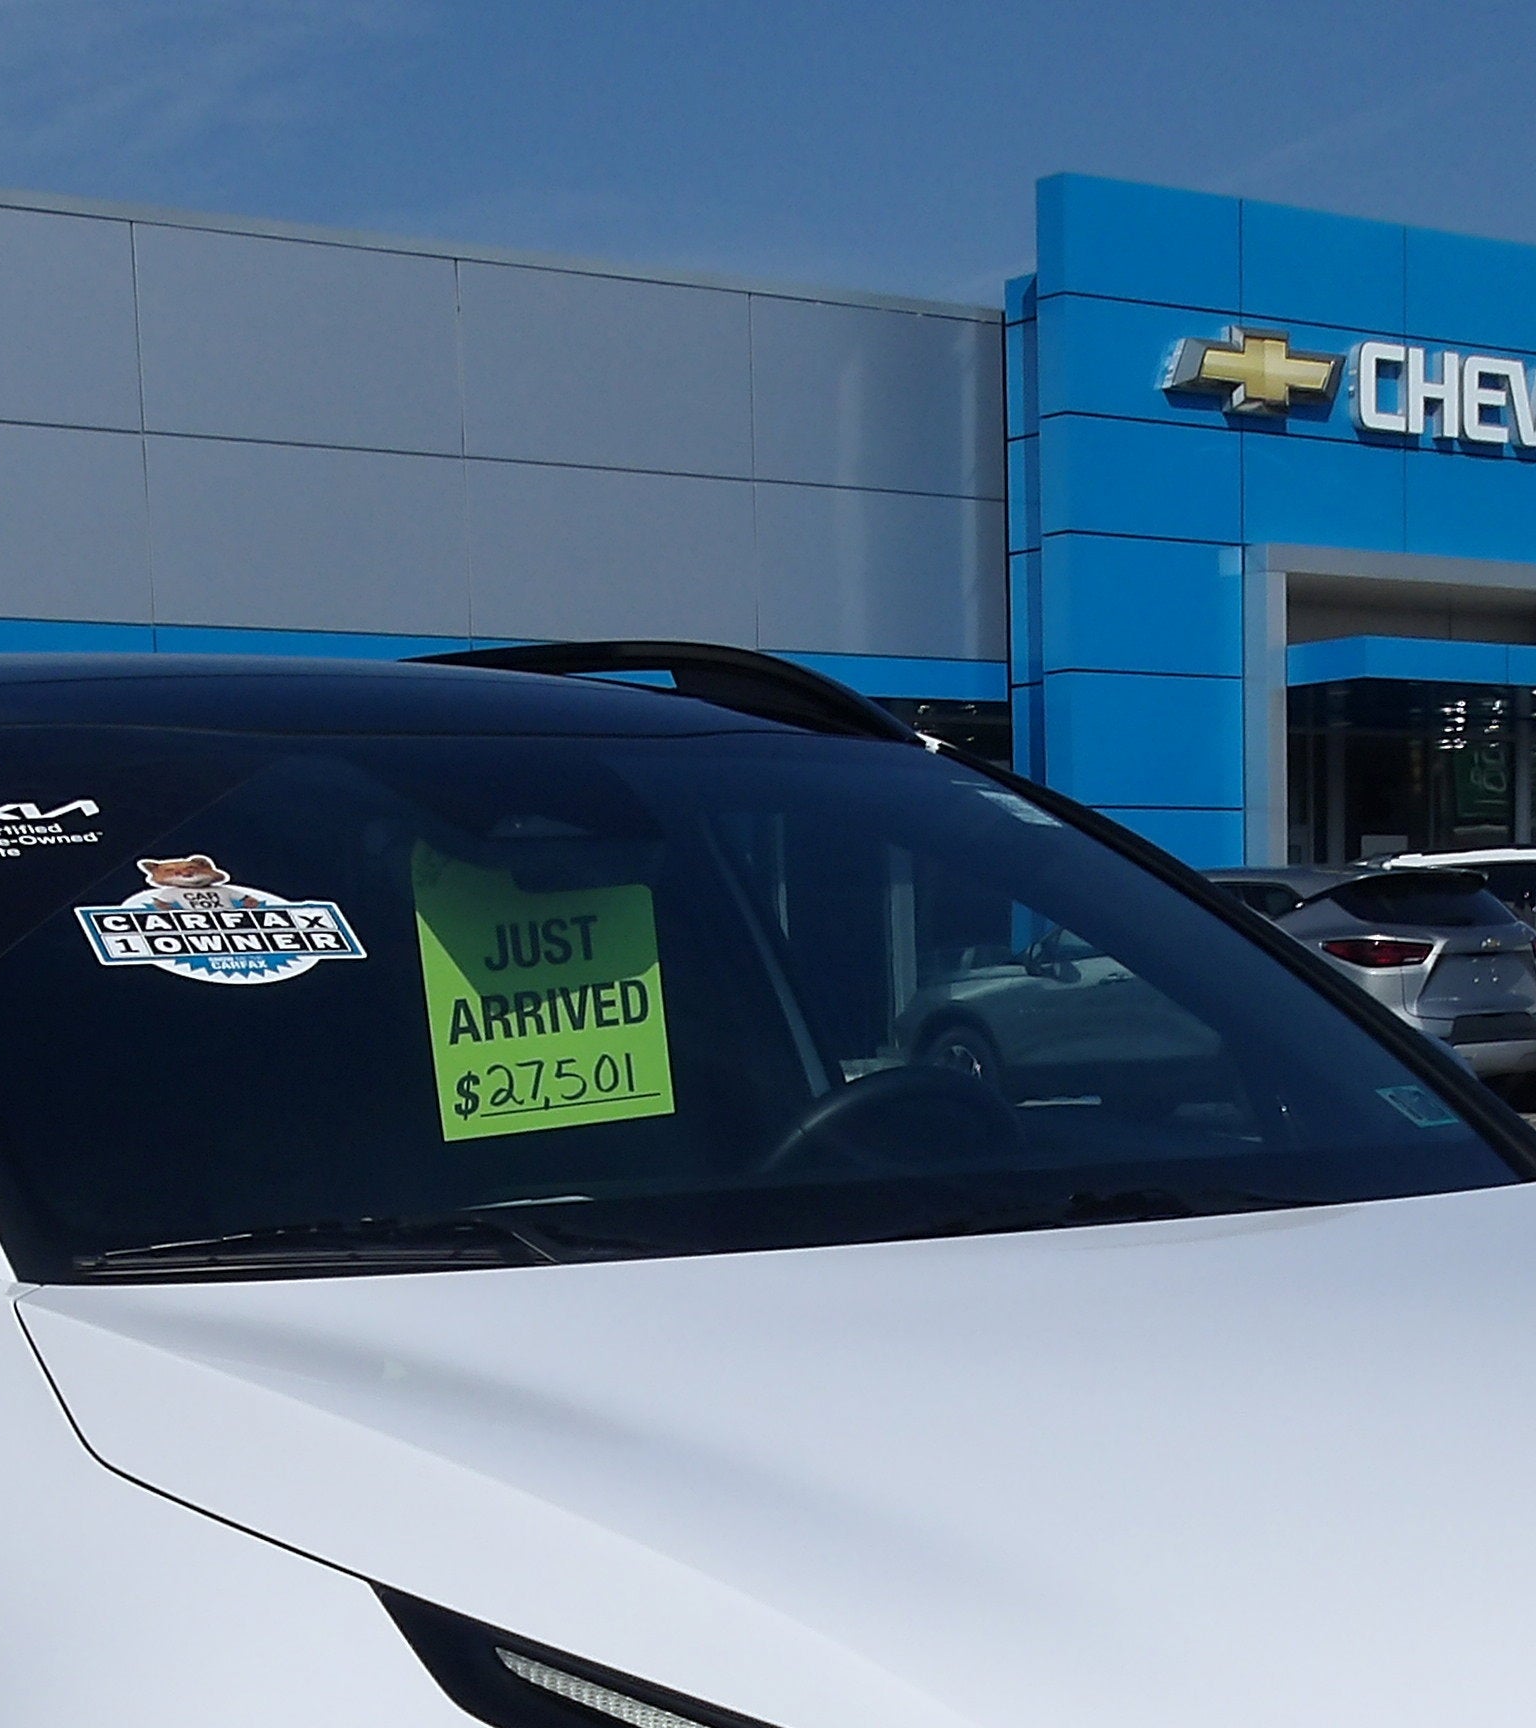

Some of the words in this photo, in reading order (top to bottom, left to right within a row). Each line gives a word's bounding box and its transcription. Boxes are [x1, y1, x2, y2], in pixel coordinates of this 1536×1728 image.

[102, 911, 330, 933] CARFAX
[153, 932, 341, 954] OWNER
[484, 915, 599, 971] JUST
[449, 979, 649, 1046] ARRIVED
